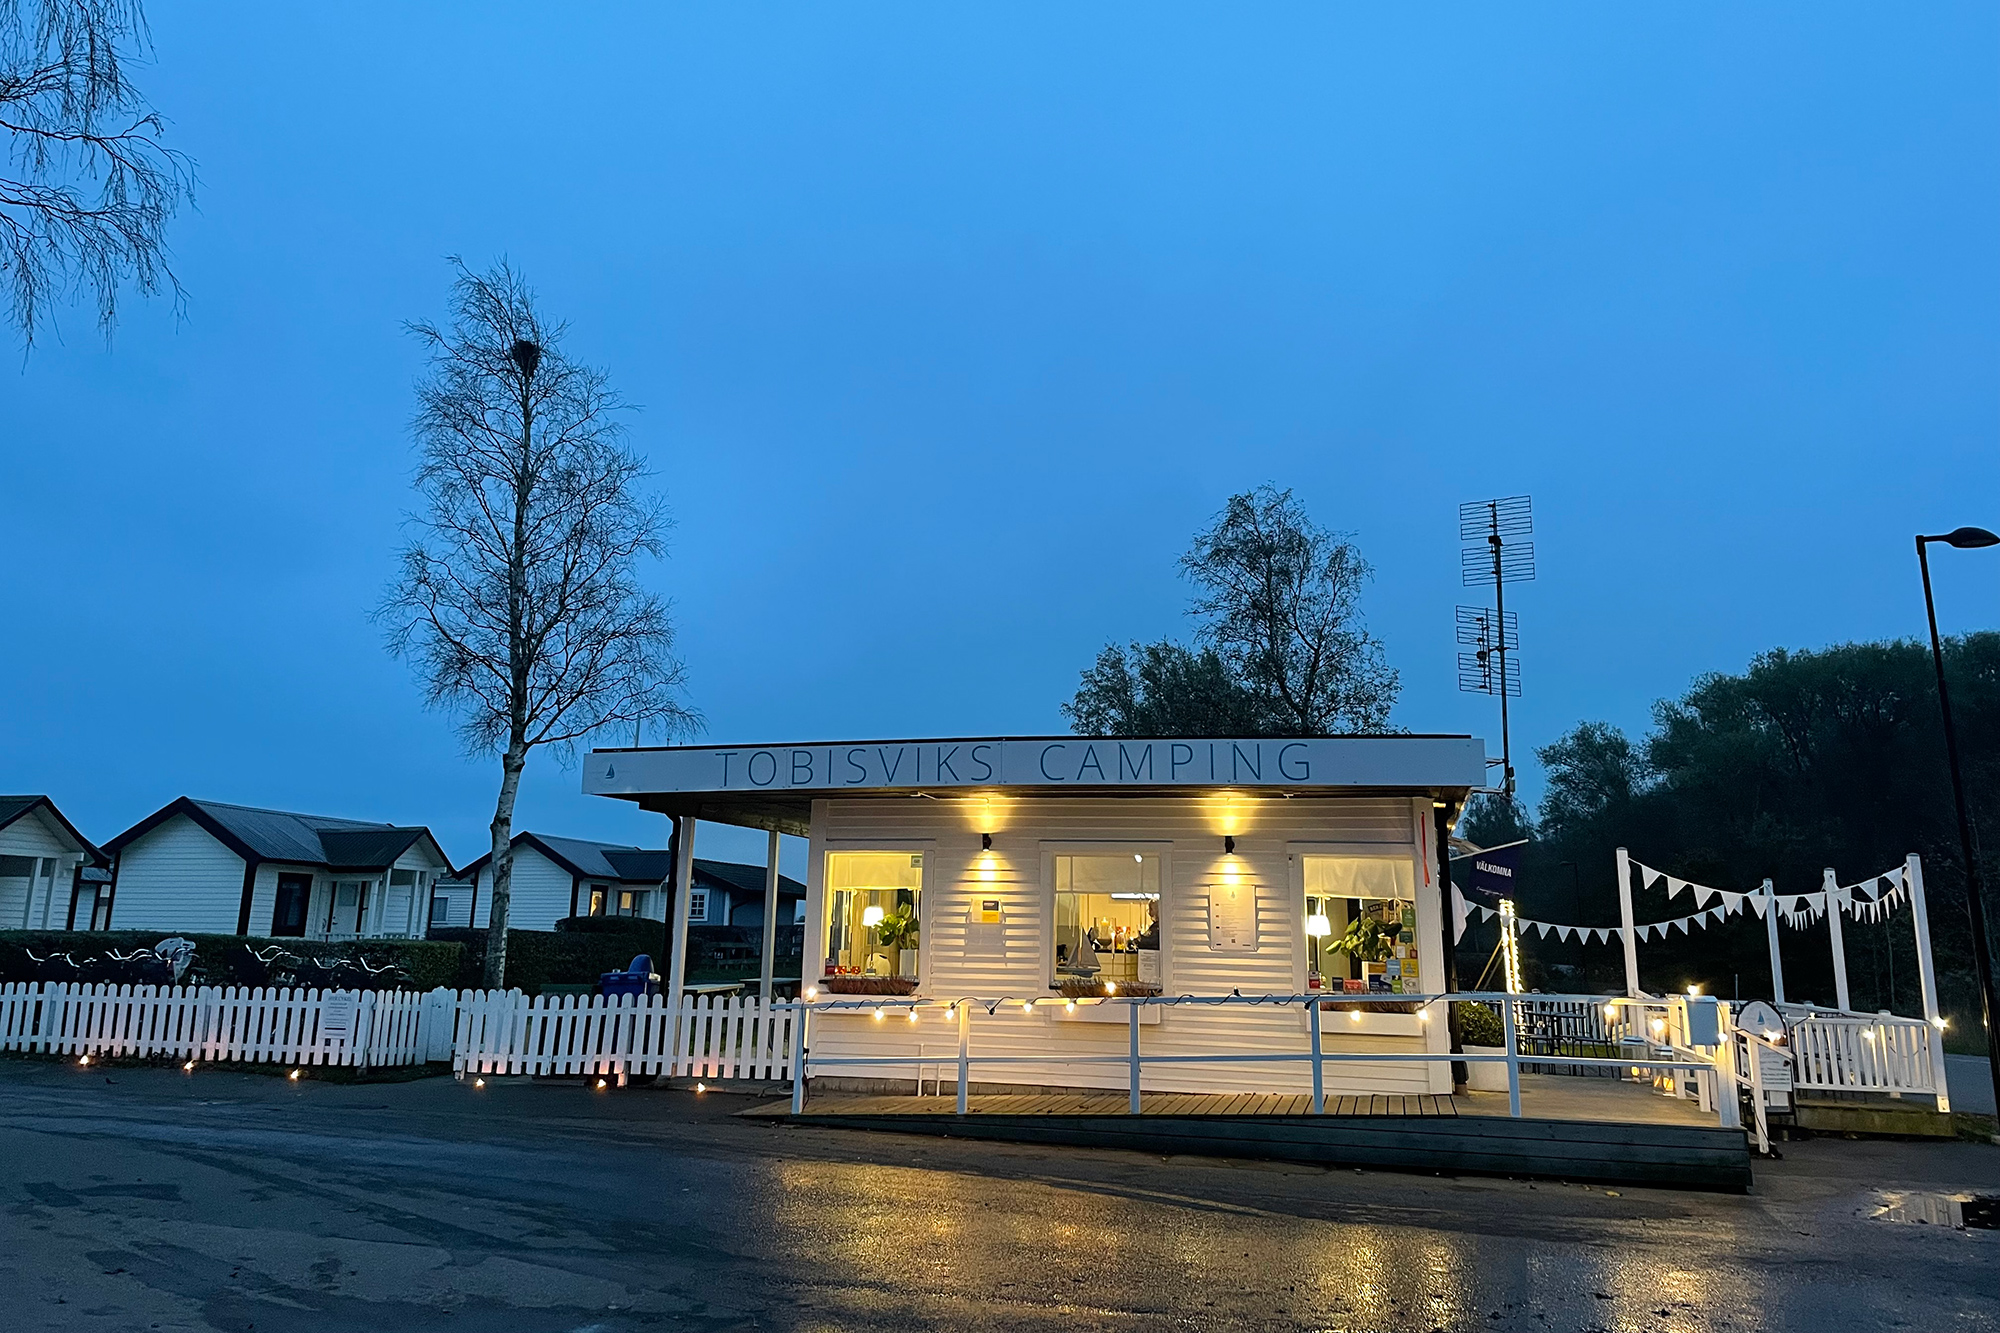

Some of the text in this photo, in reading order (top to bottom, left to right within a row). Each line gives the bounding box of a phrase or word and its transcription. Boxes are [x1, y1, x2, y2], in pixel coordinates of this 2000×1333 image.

[715, 742, 1311, 786] TOBISVIKS CAMPING
[1476, 860, 1512, 877] VÄLKOMNA
